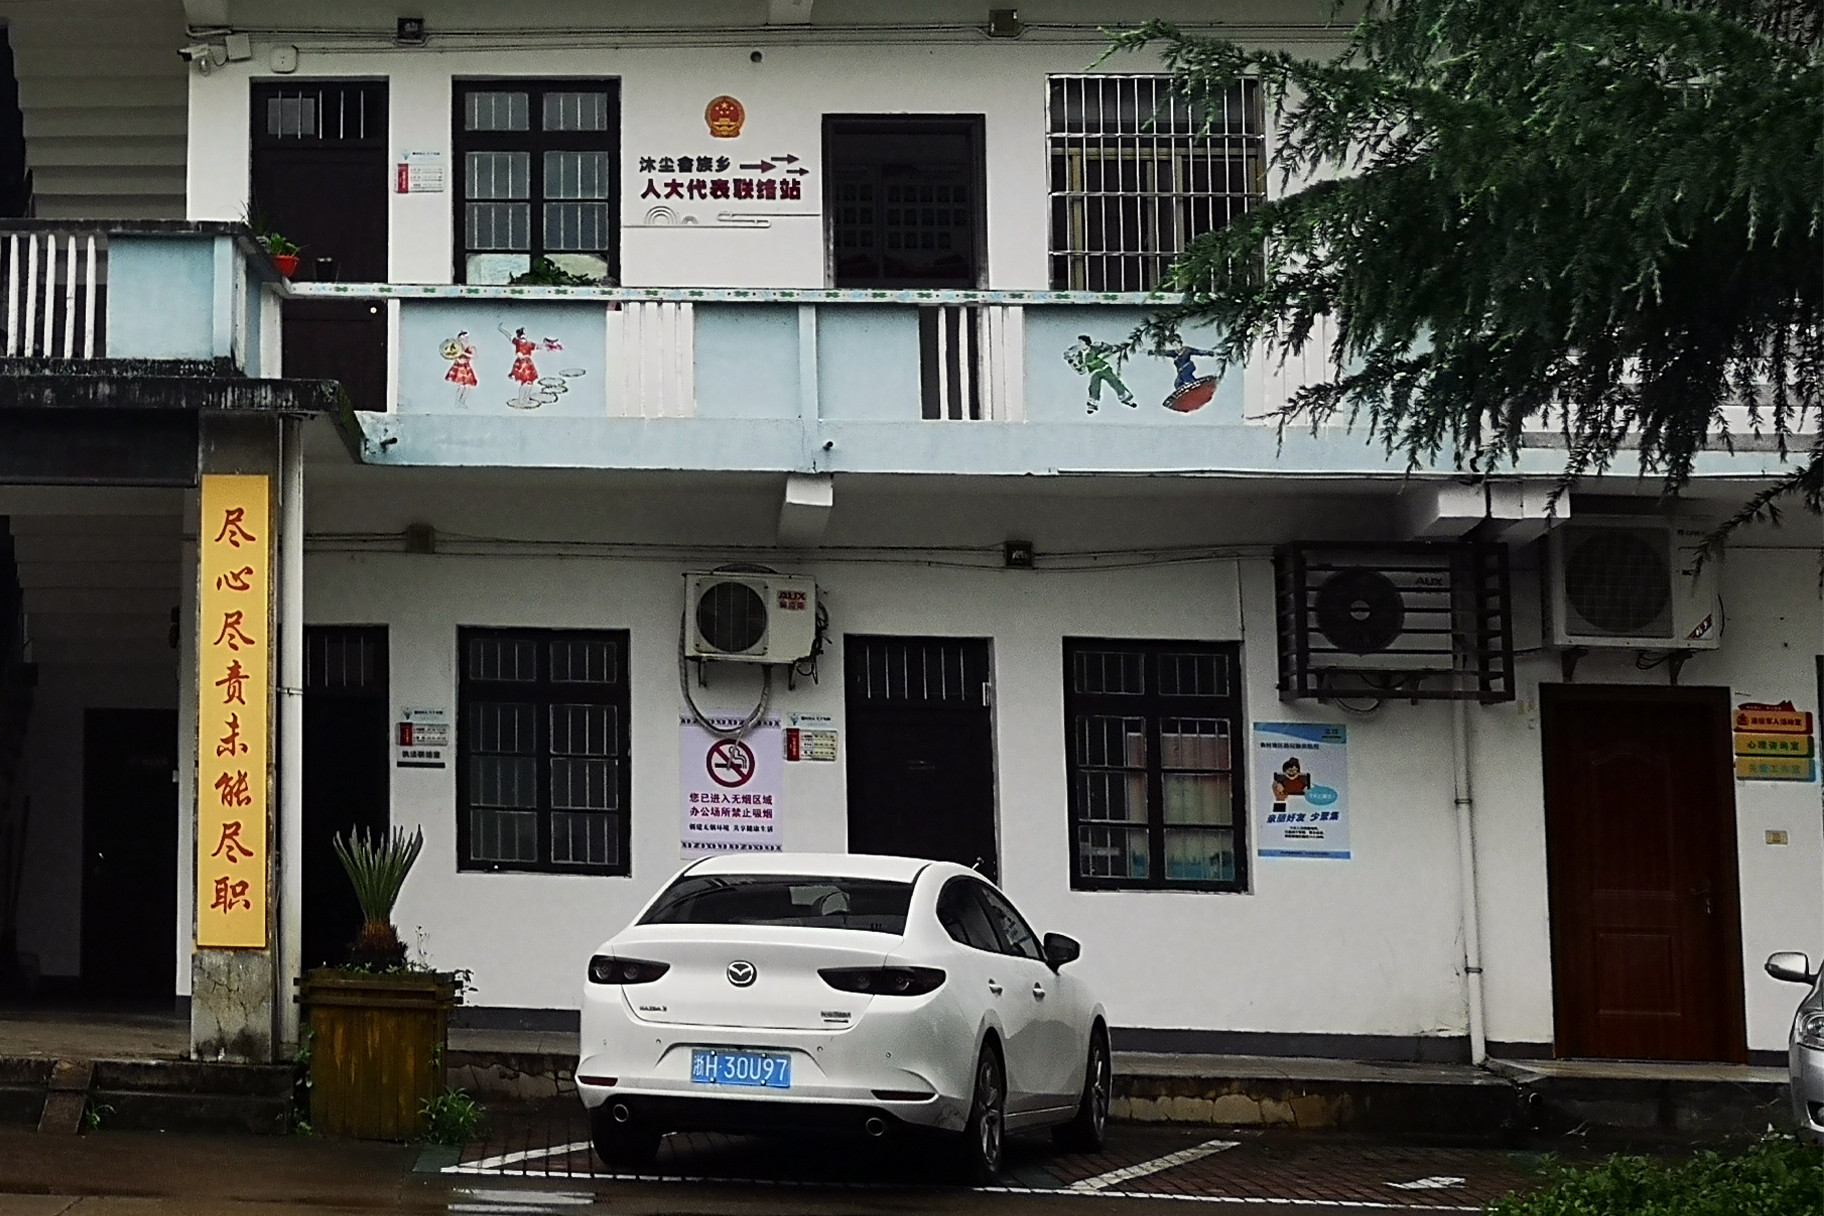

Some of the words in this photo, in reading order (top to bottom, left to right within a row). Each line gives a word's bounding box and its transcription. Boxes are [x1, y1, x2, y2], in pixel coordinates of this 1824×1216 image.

[639, 156, 731, 173] 沐尘畲族乡
[640, 178, 802, 201] 人大代表联络站
[778, 590, 806, 600] AUX
[209, 507, 257, 915] 尽心尽责未能尽职
[1747, 740, 1800, 751] 心理咨询室
[689, 792, 773, 805] 您已进入无烟区域
[689, 806, 773, 819] 办公场所禁止吸烟
